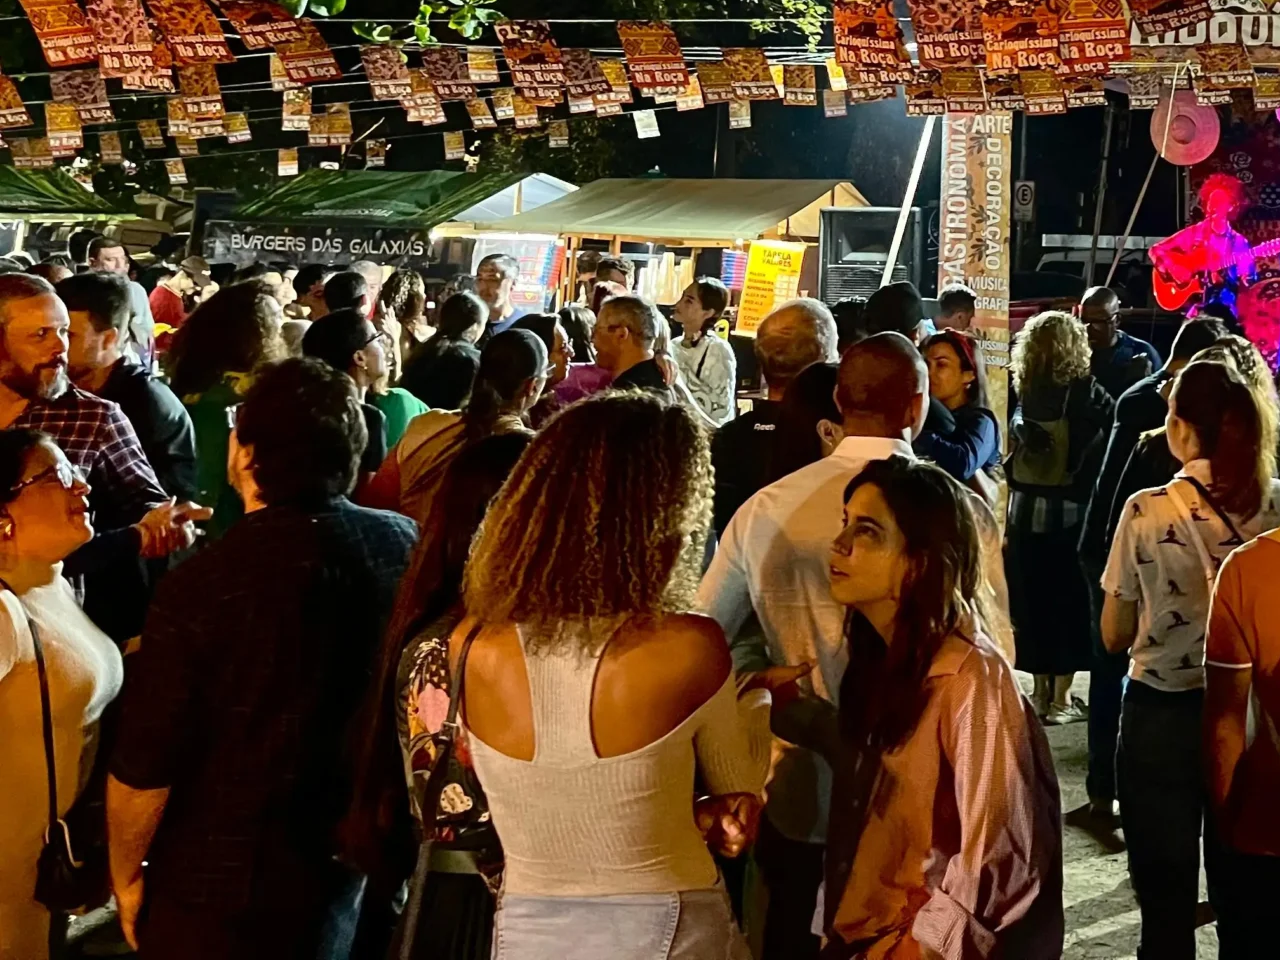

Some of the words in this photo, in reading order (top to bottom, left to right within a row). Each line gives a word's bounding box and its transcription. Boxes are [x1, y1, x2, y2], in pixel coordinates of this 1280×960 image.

[1170, 11, 1208, 29] Roça
[245, 33, 264, 46] Na
[266, 29, 301, 44] Roça
[1059, 28, 1126, 42] arioquíssima
[177, 43, 195, 57] Na
[197, 43, 227, 58] Roça
[839, 48, 856, 62] Na
[860, 49, 895, 67] Roça
[924, 44, 944, 59] Na
[948, 42, 986, 60] Roça
[1059, 43, 1079, 60] Na
[1085, 42, 1124, 59] Roça
[103, 54, 120, 68] Na
[123, 54, 153, 70] Roça
[992, 52, 1012, 69] Na
[1018, 51, 1056, 70] Roça
[515, 71, 531, 82] Na
[534, 71, 564, 83] Roça
[635, 72, 651, 83] Na
[655, 71, 684, 84] Roça
[860, 71, 876, 83] Na
[881, 69, 911, 84] Roça
[971, 115, 1011, 134] ARTE
[942, 117, 968, 289] GASTRONOMIA
[981, 137, 1004, 271] DECORAÇÃO
[1022, 189, 1028, 201] E
[231, 234, 306, 252] BURGERS
[311, 238, 342, 253] DAS
